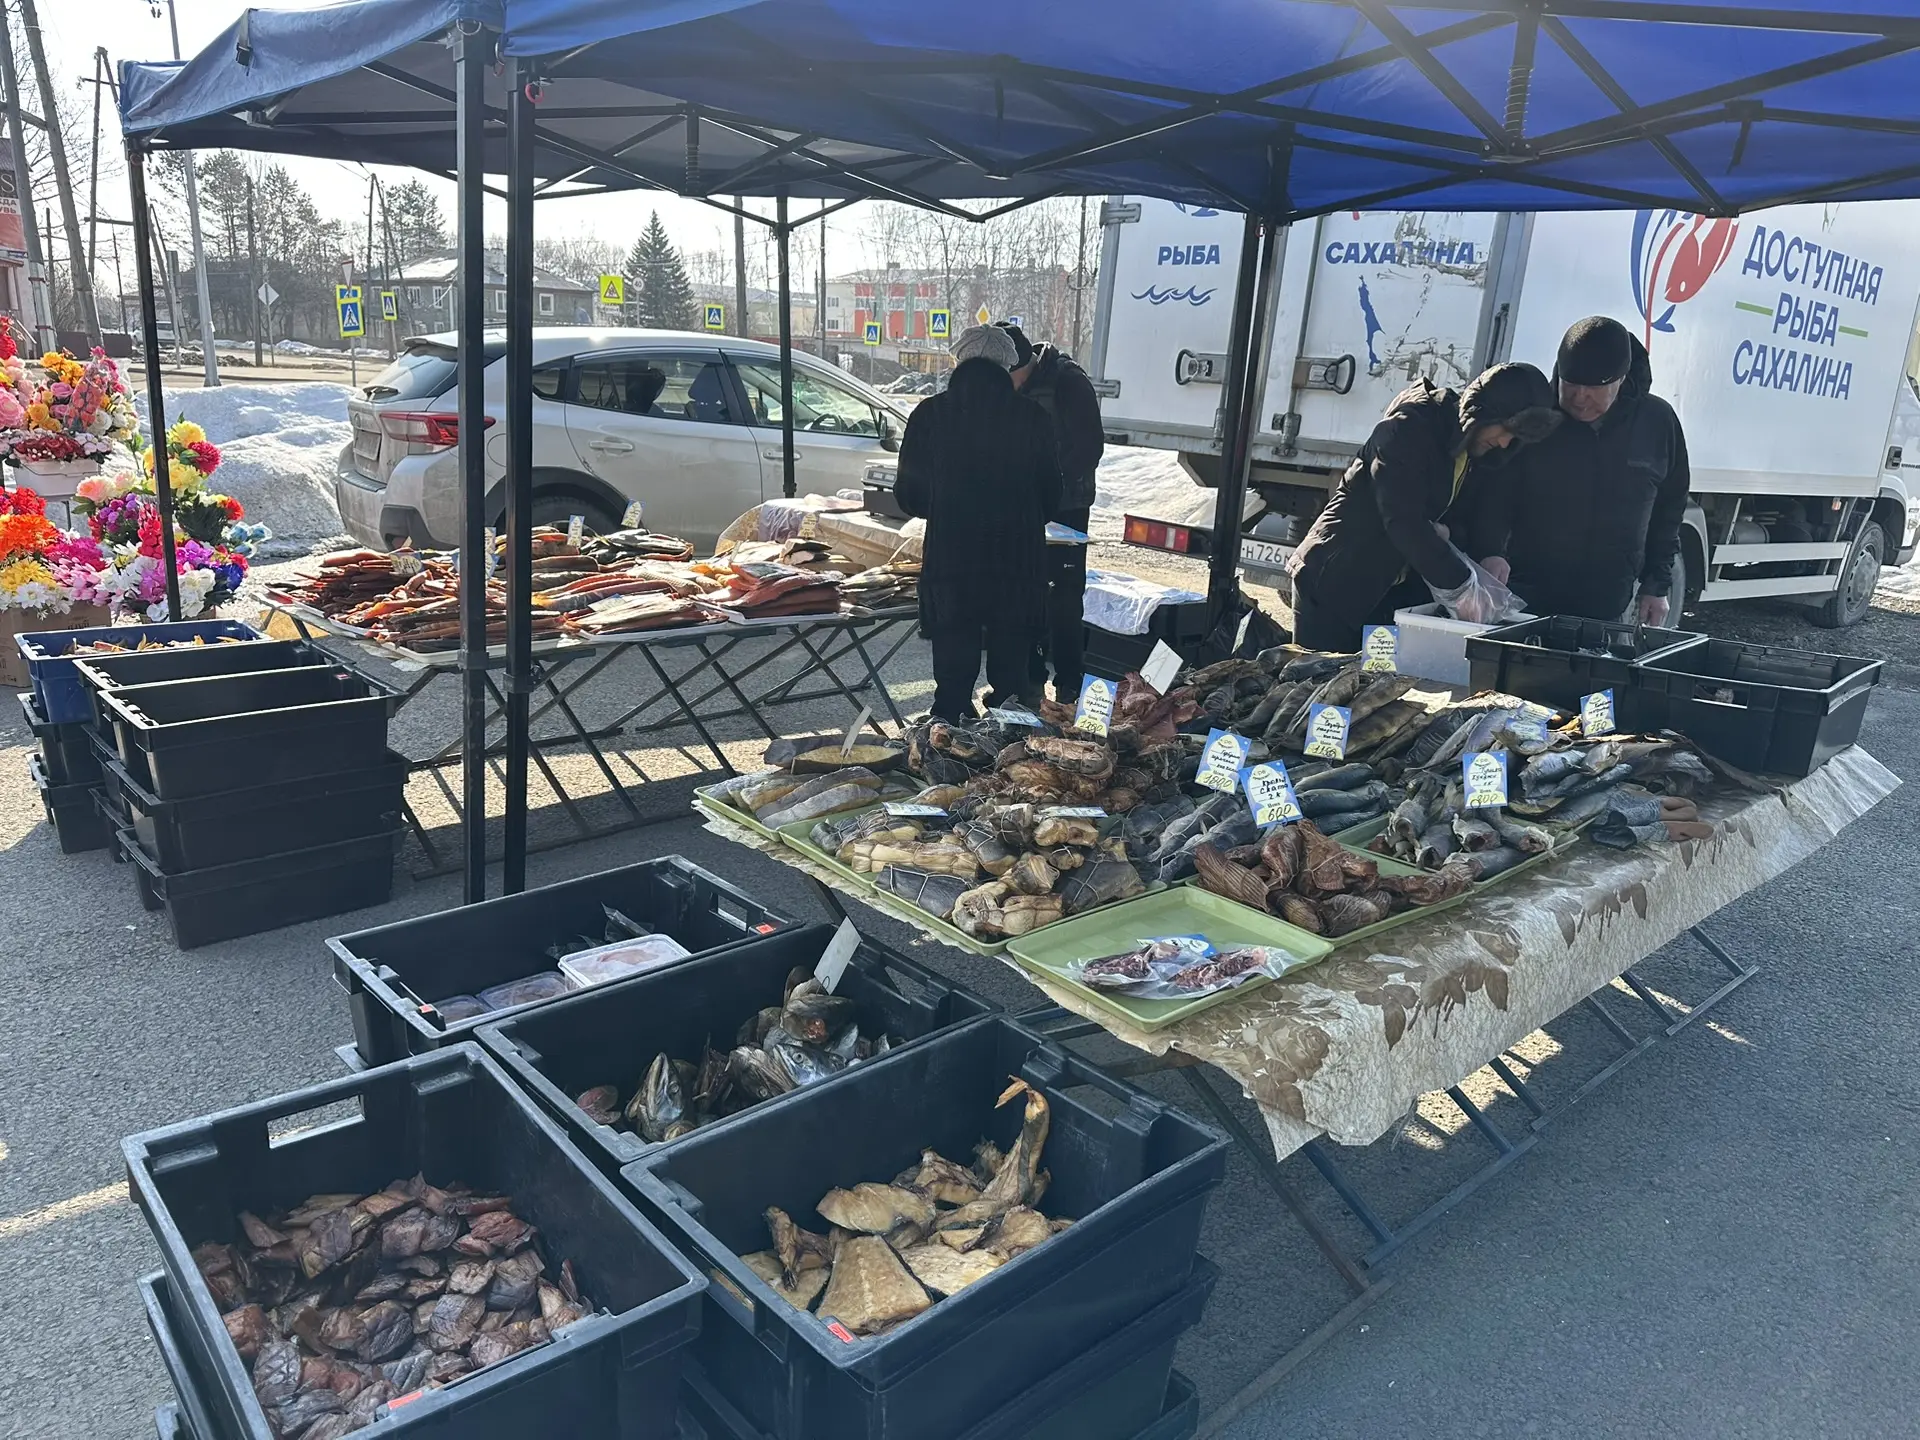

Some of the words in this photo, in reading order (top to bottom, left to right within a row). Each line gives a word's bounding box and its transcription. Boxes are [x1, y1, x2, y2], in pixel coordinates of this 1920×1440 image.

[1157, 244, 1221, 266] РЫБА
[1325, 241, 1475, 265] САХАЛИНА
[1742, 225, 1884, 305] ДОСТУПНАЯ
[1772, 292, 1839, 347] РЫБА
[1732, 339, 1853, 400] САХАЛИНА
